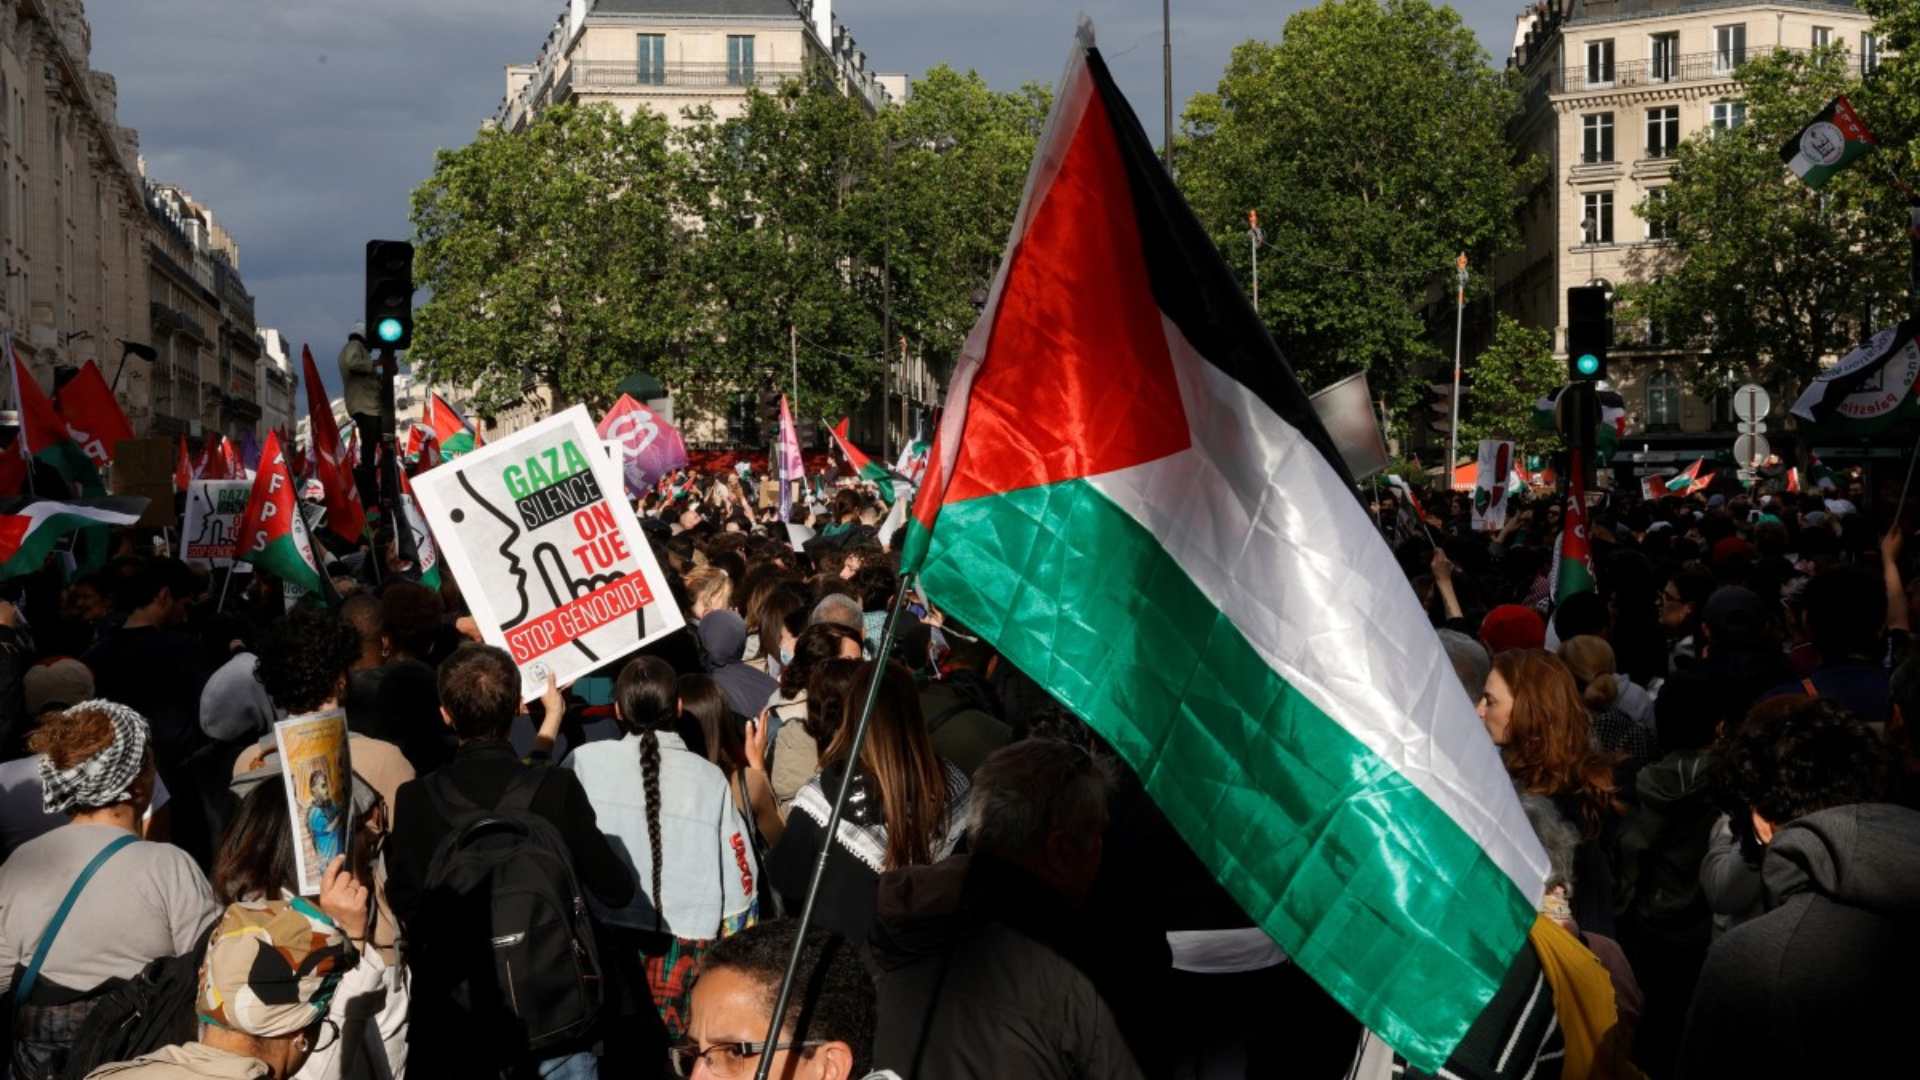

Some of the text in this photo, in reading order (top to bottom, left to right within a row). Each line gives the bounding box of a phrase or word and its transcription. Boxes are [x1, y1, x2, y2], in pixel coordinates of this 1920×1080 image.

[503, 439, 589, 500] GAZA
[519, 471, 599, 527] SILENCE
[573, 500, 618, 541] ON
[572, 530, 631, 575] TUE
[511, 576, 649, 660] STOP GÉNOCIDE
